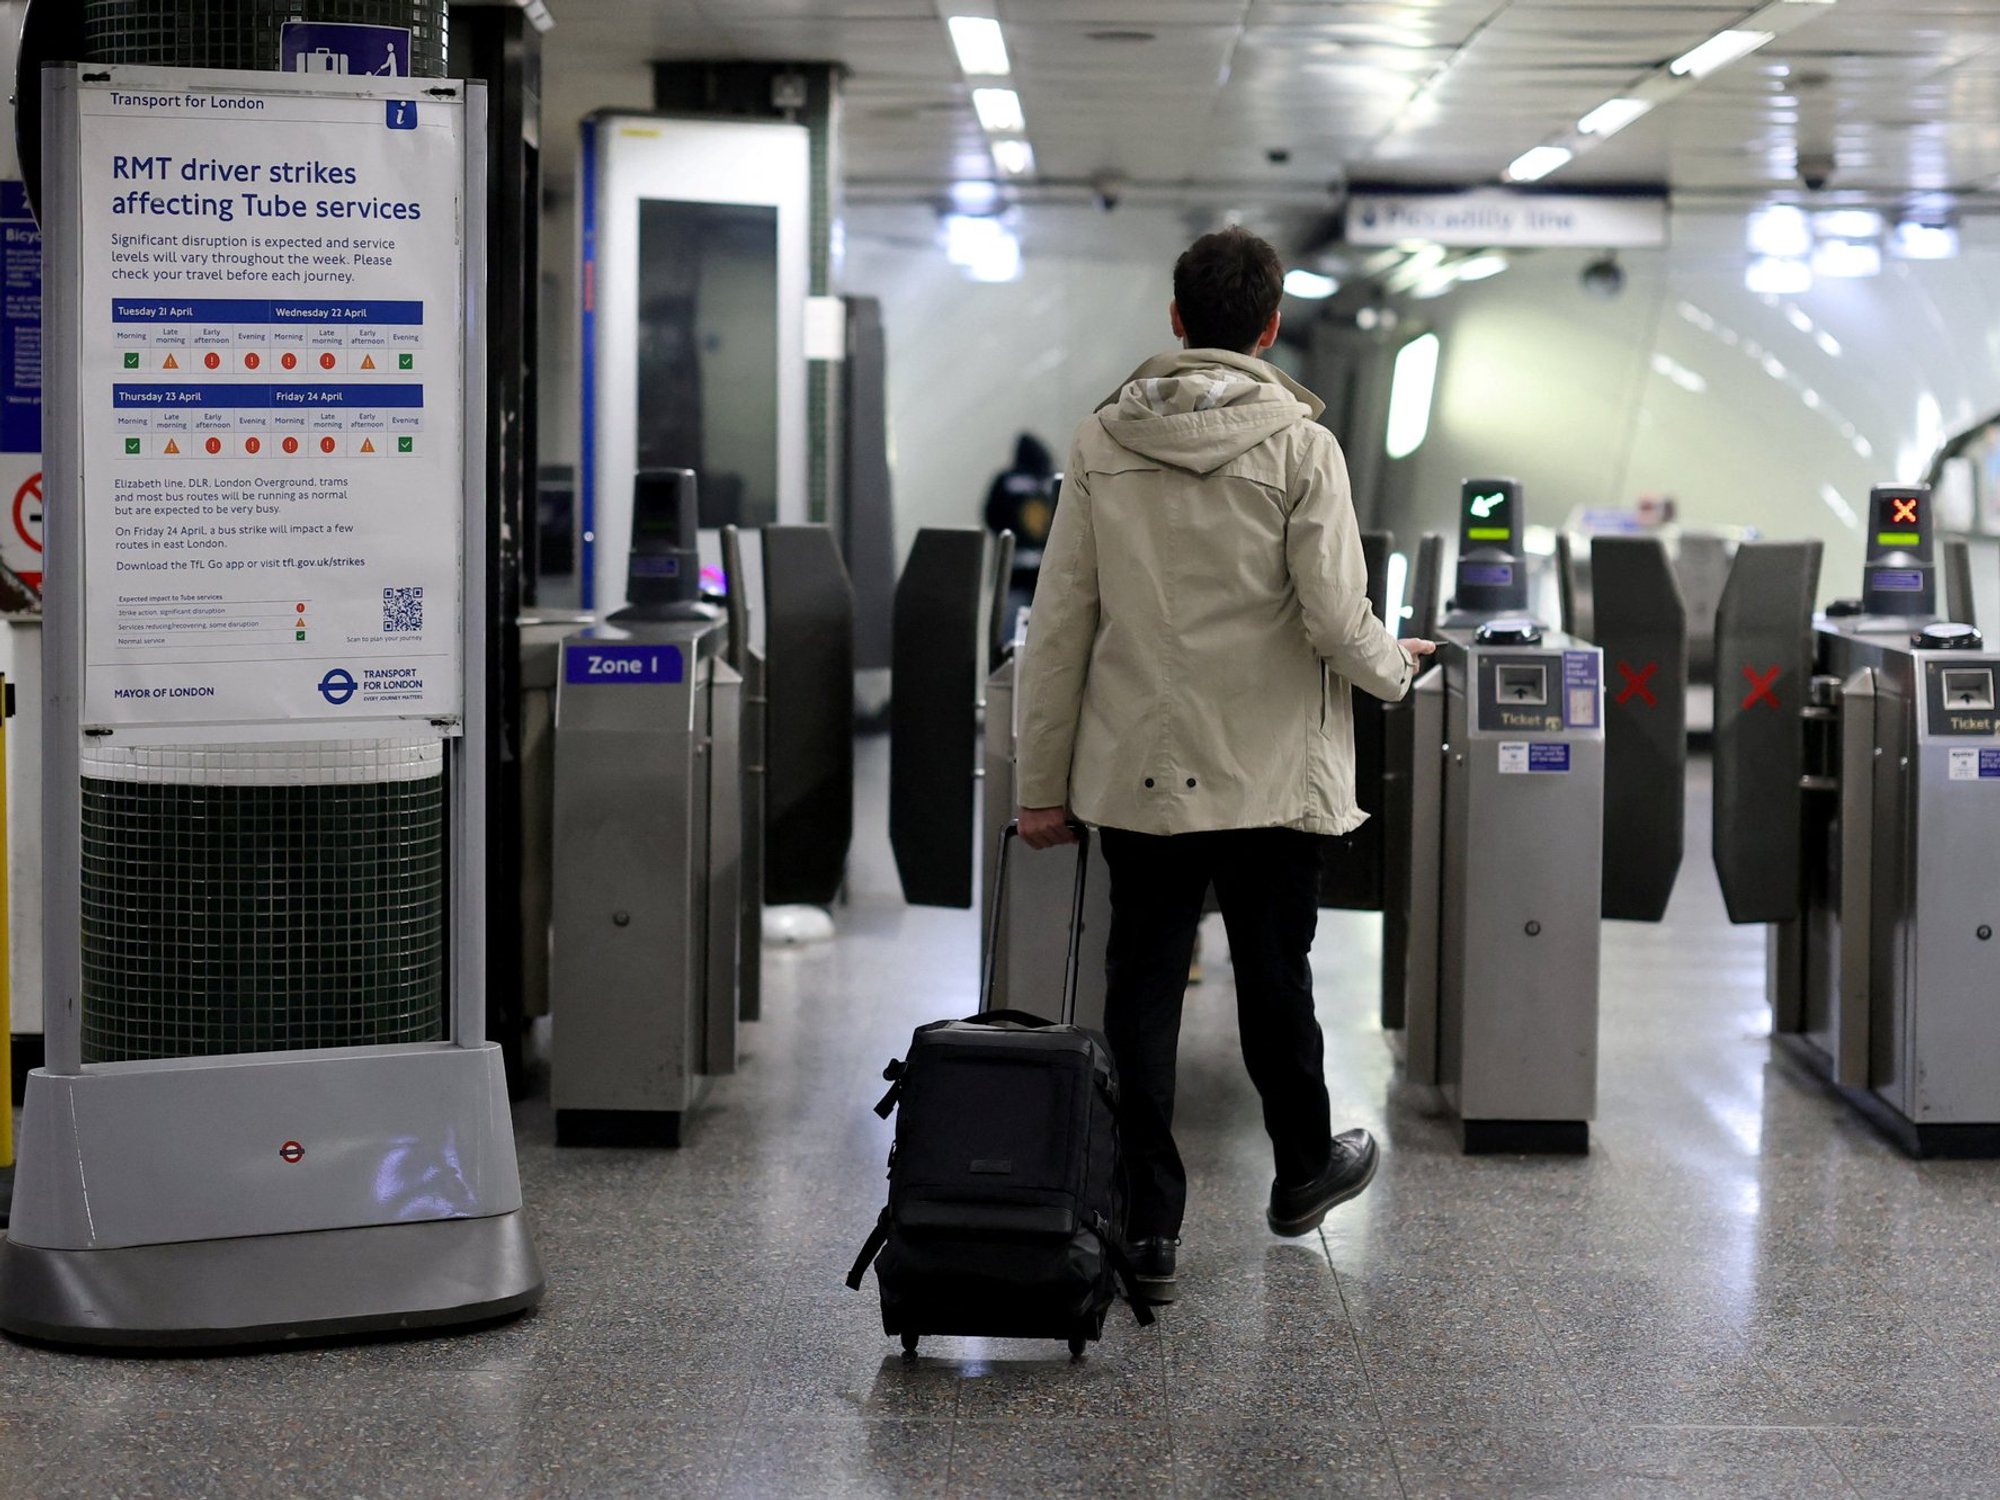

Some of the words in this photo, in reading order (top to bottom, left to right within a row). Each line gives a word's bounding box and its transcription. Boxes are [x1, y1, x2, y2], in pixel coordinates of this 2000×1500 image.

[111, 92, 180, 108] Transport
[186, 95, 206, 108] for
[211, 96, 264, 109] London
[113, 156, 172, 180] RMT
[181, 159, 261, 182] driver
[269, 162, 356, 184] strikes
[112, 192, 233, 221] affecting
[242, 194, 307, 217] Tube
[316, 197, 421, 220] services
[111, 234, 178, 248] Significant
[182, 235, 247, 249] disruption
[251, 236, 261, 247] is
[265, 237, 322, 249] expected
[326, 237, 348, 248] and
[353, 238, 395, 249] service
[112, 251, 149, 263] levels
[154, 252, 177, 263] will
[181, 255, 207, 265] vary
[210, 253, 284, 266] throughout
[288, 254, 309, 265] the
[313, 254, 350, 265] week.
[354, 255, 392, 266] Please
[112, 269, 149, 280] check
[154, 271, 182, 282] your
[186, 269, 222, 281] travel
[227, 270, 267, 281] before
[272, 270, 299, 281] each
[303, 271, 354, 283] journey.
[118, 306, 156, 317] Tuesday
[159, 307, 167, 315] 21
[170, 307, 193, 317] April
[275, 308, 328, 318] Wednesday
[331, 309, 342, 317] 22
[344, 309, 367, 318] April
[156, 337, 185, 345] morning
[238, 333, 265, 341] Evening
[393, 334, 419, 342] Evening
[119, 392, 163, 402] Thursday
[165, 392, 176, 401] 23
[178, 392, 201, 402] April
[276, 392, 304, 402] Friday
[308, 392, 318, 401] 24
[320, 392, 343, 402] April
[275, 417, 304, 425] Morning
[360, 413, 375, 421] Early
[392, 417, 419, 425] Evening
[157, 422, 187, 430] morning
[115, 479, 161, 488] Elizabeth
[214, 478, 251, 488] London
[115, 493, 133, 502] and
[137, 493, 163, 502] most
[166, 492, 184, 501] bus
[187, 492, 219, 501] routes
[222, 491, 239, 500] will
[242, 491, 255, 500] be
[257, 491, 296, 502] running
[312, 490, 347, 499] normal
[115, 506, 132, 515] but
[135, 507, 151, 515] are
[154, 506, 200, 517] expected
[203, 506, 213, 514] to
[217, 505, 228, 514] be
[231, 506, 253, 515] very
[256, 505, 281, 515] busy.
[115, 527, 131, 536] On
[134, 527, 164, 537] Friday
[167, 527, 177, 535] 24
[218, 526, 236, 535] bus
[239, 525, 267, 534] strike
[270, 525, 287, 534] will
[290, 525, 324, 535] impact
[334, 524, 354, 533] few
[116, 540, 149, 549] routes
[151, 540, 160, 549] in
[164, 541, 184, 549] east
[187, 539, 227, 549] London.
[116, 561, 168, 571] Download
[171, 561, 187, 570] the
[190, 560, 205, 569] TfL
[208, 560, 223, 569] Go
[226, 562, 244, 571] app
[260, 559, 280, 568] visit
[283, 558, 365, 568] tfl.gov.uk/strikes
[588, 656, 642, 674] Zone
[364, 669, 416, 678] TRANSPORT
[364, 681, 381, 690] FOR
[384, 680, 422, 689] LONDON
[115, 689, 150, 698] MAYOR
[153, 689, 167, 697] OF
[169, 687, 214, 697] LONDON
[1502, 712, 1540, 725] Ticket
[1951, 717, 1990, 730] Ticket
